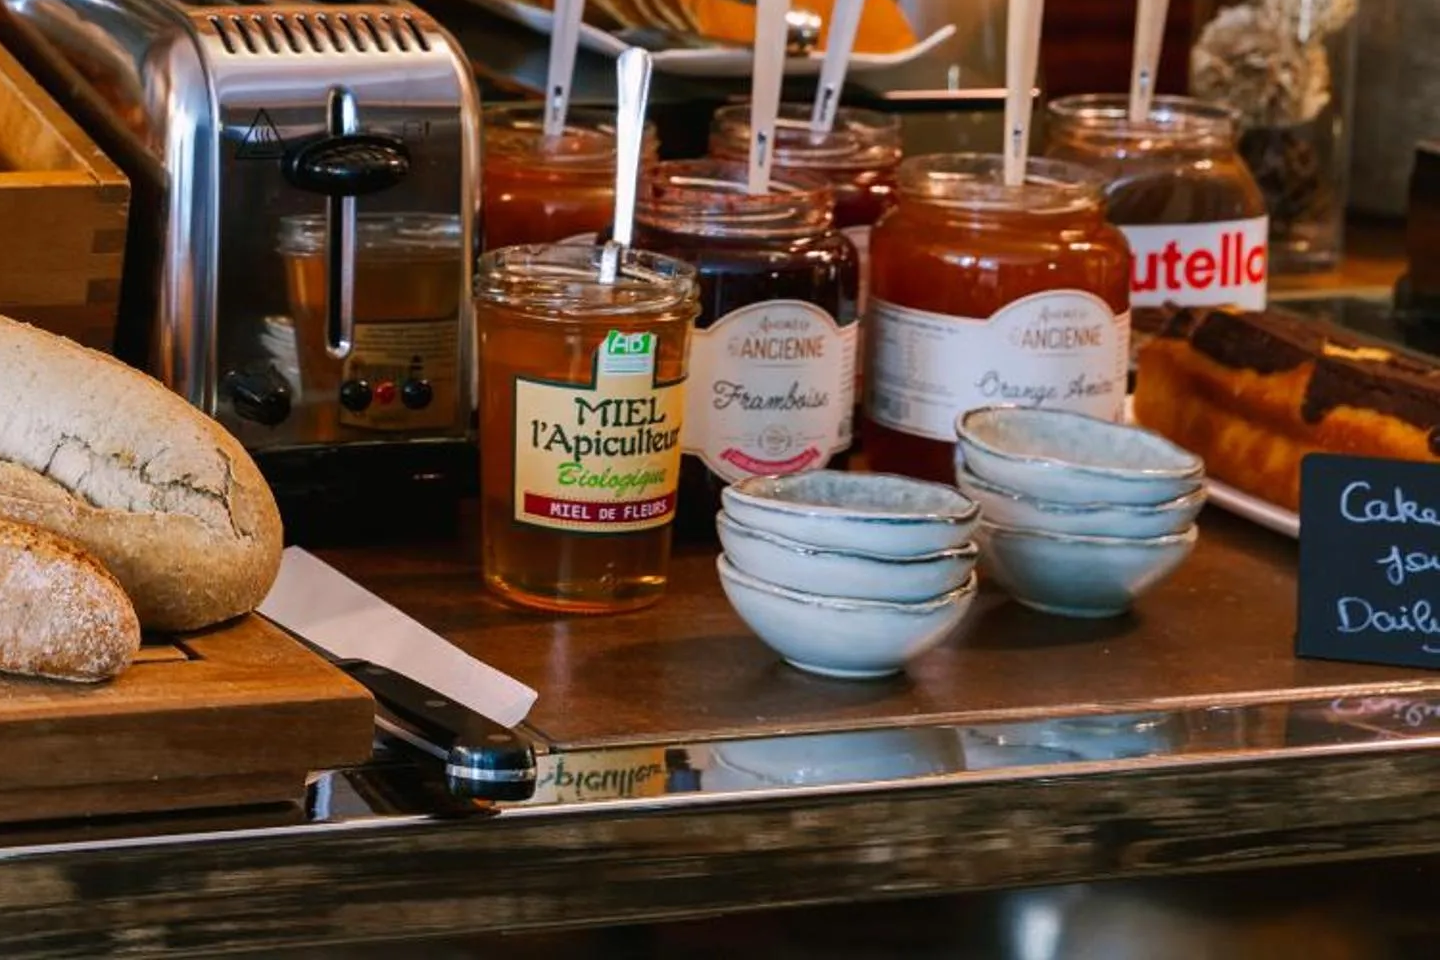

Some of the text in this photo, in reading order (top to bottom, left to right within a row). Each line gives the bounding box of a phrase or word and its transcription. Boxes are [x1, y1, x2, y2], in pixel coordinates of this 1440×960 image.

[1128, 231, 1266, 293] utella
[740, 334, 825, 360] ANCIENNE
[974, 369, 1058, 407] Orange
[574, 396, 667, 427] MIEL
[531, 419, 681, 463] l'Apiculteur
[557, 462, 667, 498] Biologique
[549, 499, 668, 520] MIEL DE FLEURS
[1340, 480, 1440, 526] Cake
